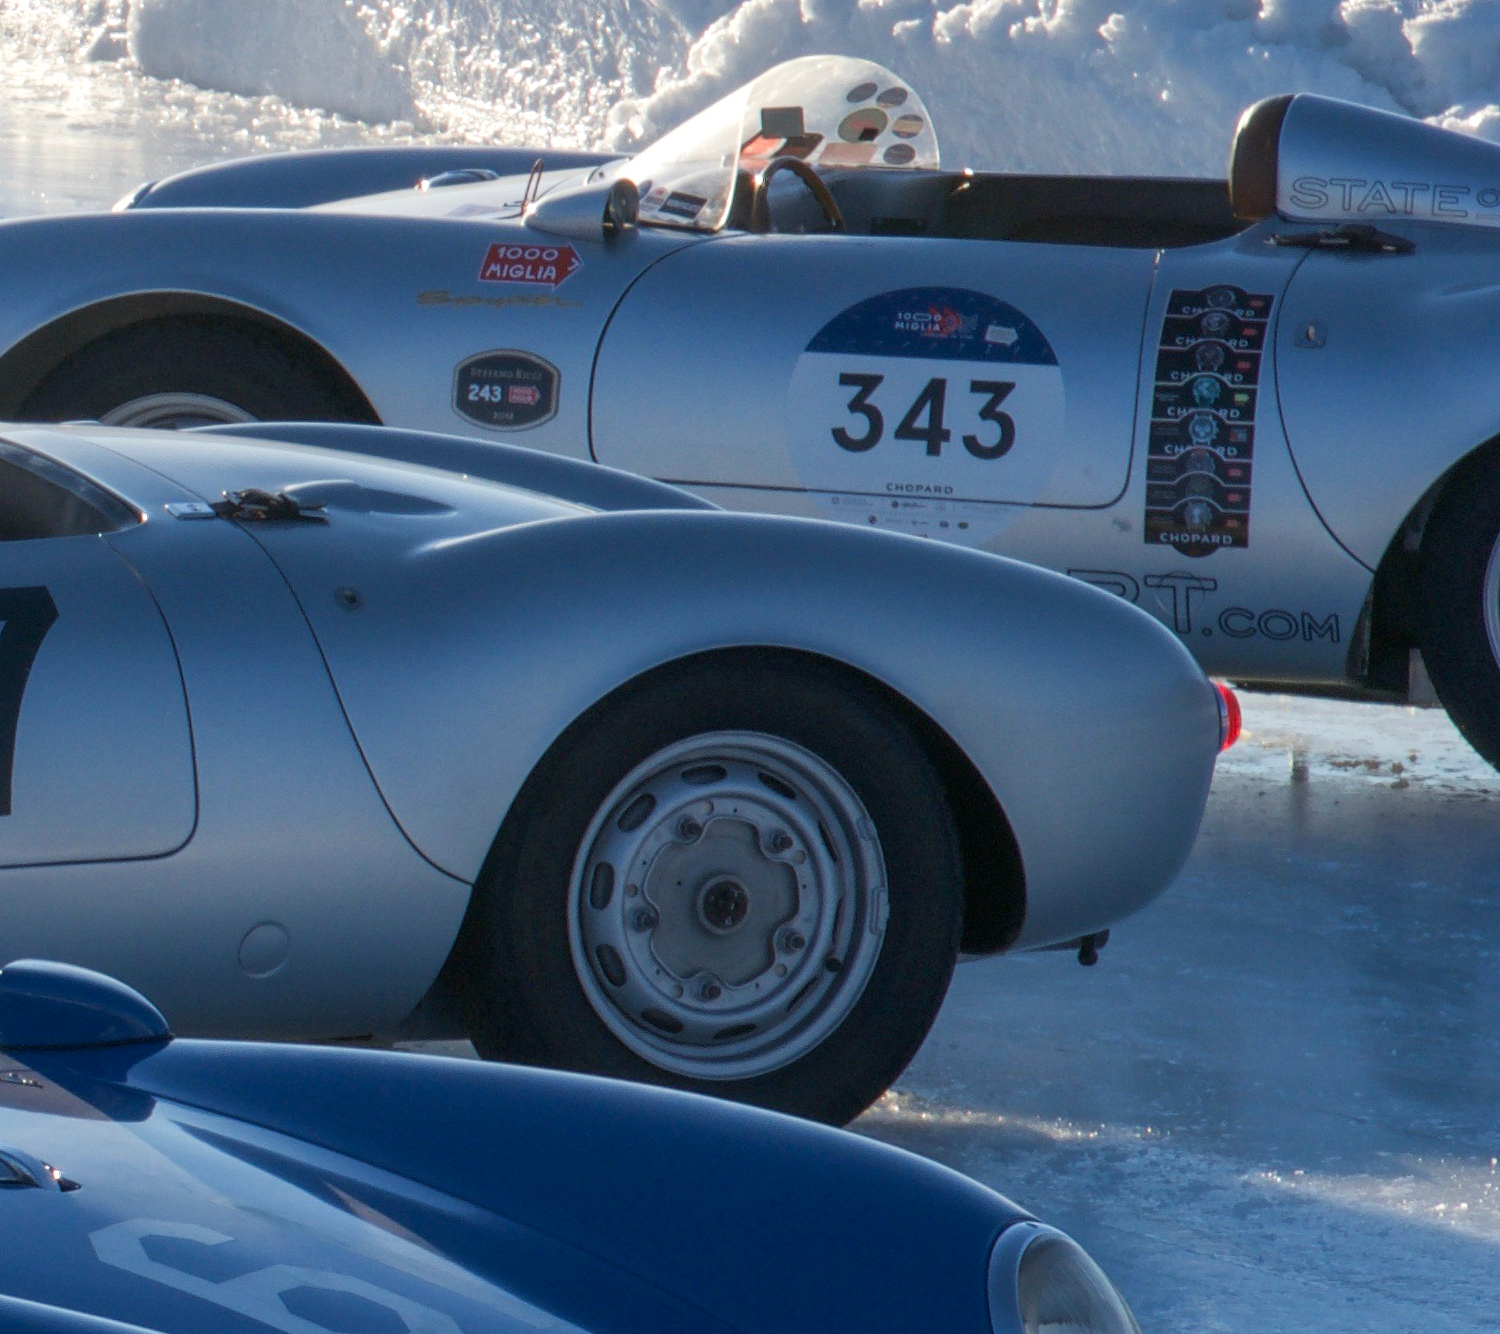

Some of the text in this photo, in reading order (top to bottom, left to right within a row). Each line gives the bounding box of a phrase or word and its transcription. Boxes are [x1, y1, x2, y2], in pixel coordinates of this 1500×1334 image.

[1290, 177, 1471, 218] STATE
[497, 246, 559, 261] 1000
[486, 263, 557, 280] MIGLIA
[468, 384, 502, 403] 243
[831, 372, 1016, 460] 343
[886, 482, 953, 494] CHOPARD
[1159, 532, 1233, 544] CHOPARD
